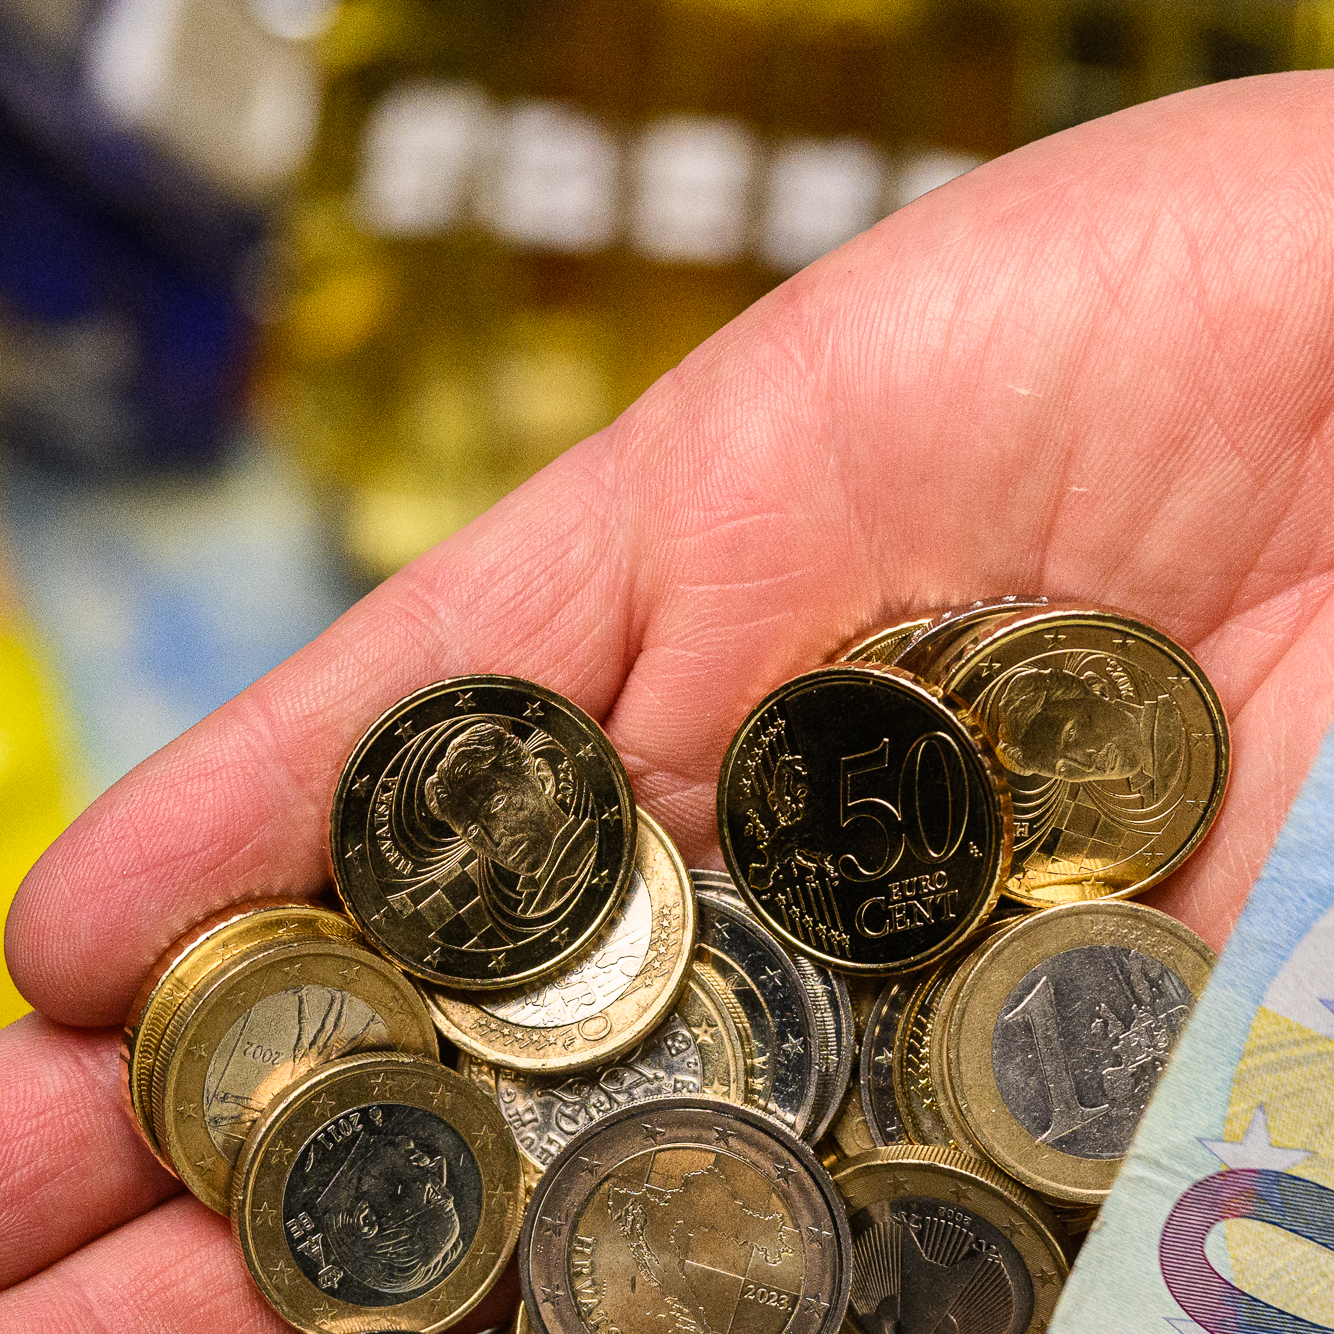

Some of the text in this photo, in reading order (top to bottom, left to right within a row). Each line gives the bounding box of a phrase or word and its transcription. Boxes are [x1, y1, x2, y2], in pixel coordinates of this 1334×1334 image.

[374, 775, 415, 876] HRVATSKA
[838, 731, 969, 883] 50
[887, 870, 948, 902] EURO
[855, 889, 959, 939] CENT
[244, 1041, 284, 1067] 2002
[1004, 974, 1110, 1144] 1
[316, 1112, 364, 1150] 2011
[742, 1281, 794, 1313] 2023.
